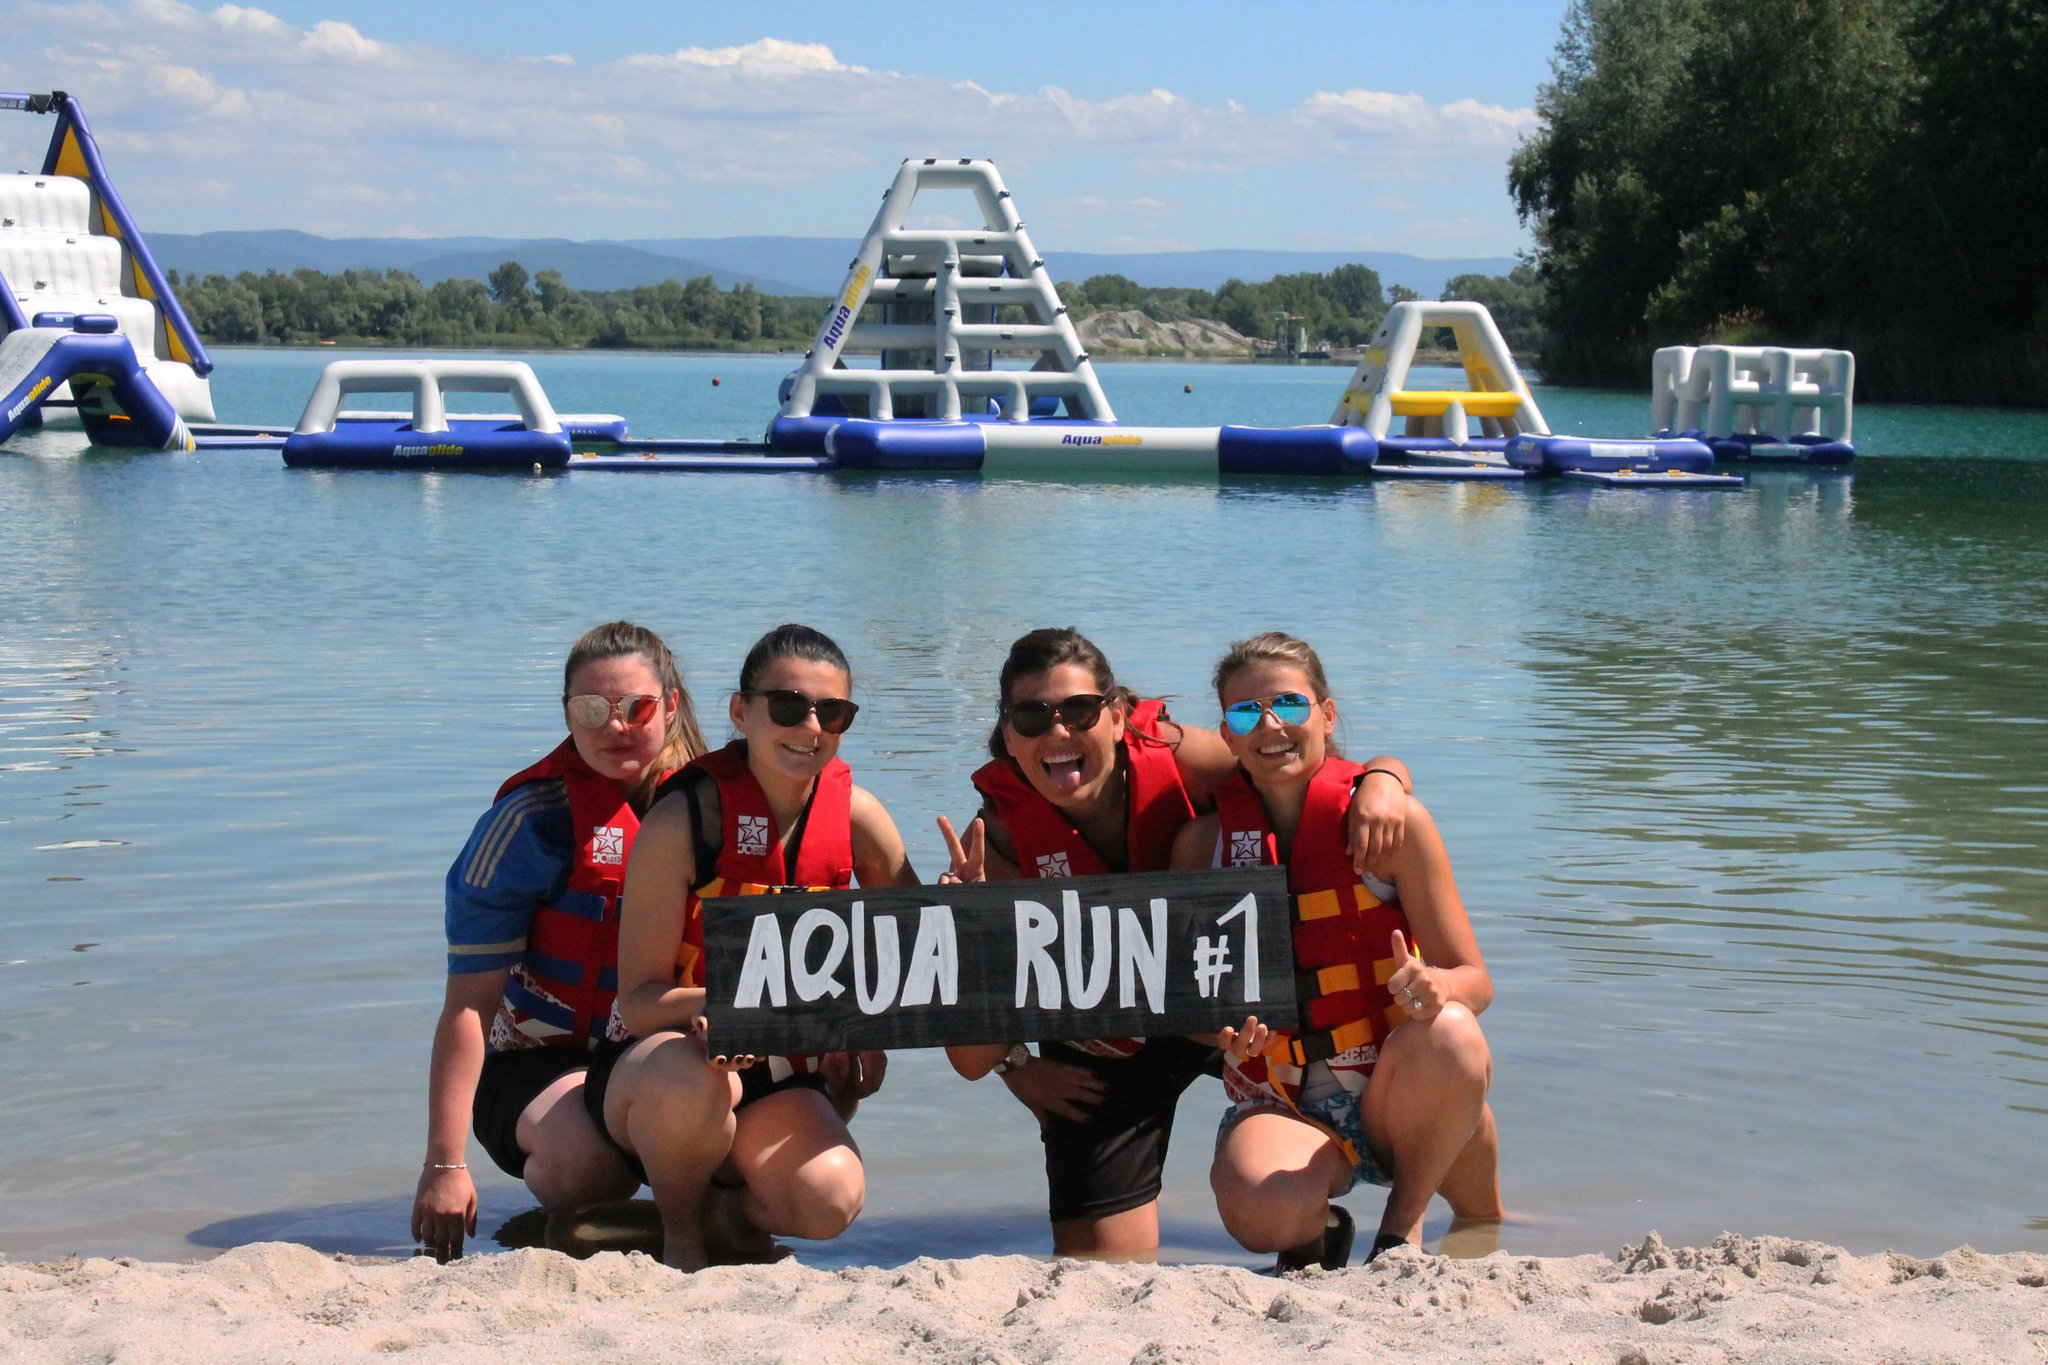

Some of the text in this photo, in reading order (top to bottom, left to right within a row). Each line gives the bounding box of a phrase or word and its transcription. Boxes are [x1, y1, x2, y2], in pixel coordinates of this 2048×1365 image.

[823, 265, 870, 350] Aquaglide
[7, 376, 52, 422] Aquaglide
[1062, 434, 1143, 446] Aquaglide
[393, 444, 464, 457] Aquaglide
[737, 843, 767, 856] JOBE
[592, 852, 623, 865] JOBE
[733, 889, 1261, 1015] AQUA RUN #1
